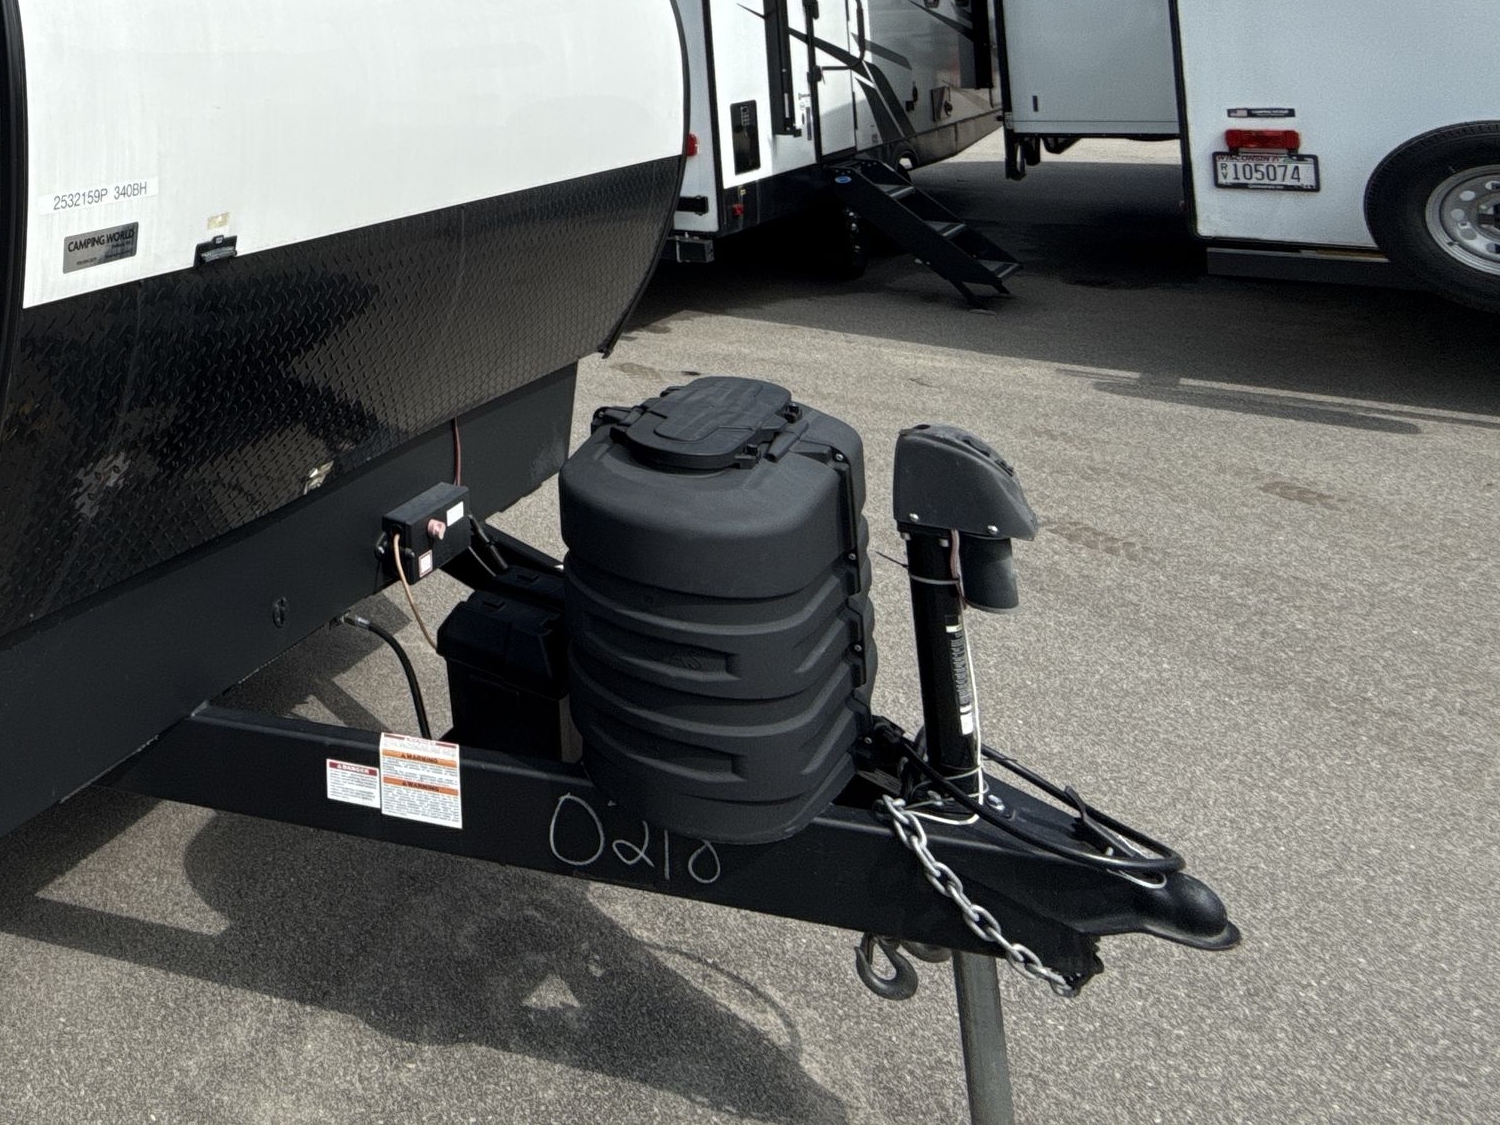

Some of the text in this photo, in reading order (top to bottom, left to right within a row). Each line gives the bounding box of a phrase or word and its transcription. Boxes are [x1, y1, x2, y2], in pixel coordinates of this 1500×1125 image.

[1232, 163, 1301, 182] 105074
[53, 181, 147, 210] 2532159P 340BH
[67, 234, 106, 252] CAMPING
[105, 229, 135, 244] WORLD
[406, 752, 438, 764] WARNING
[341, 762, 370, 774] DANGER
[407, 781, 440, 793] WARNING
